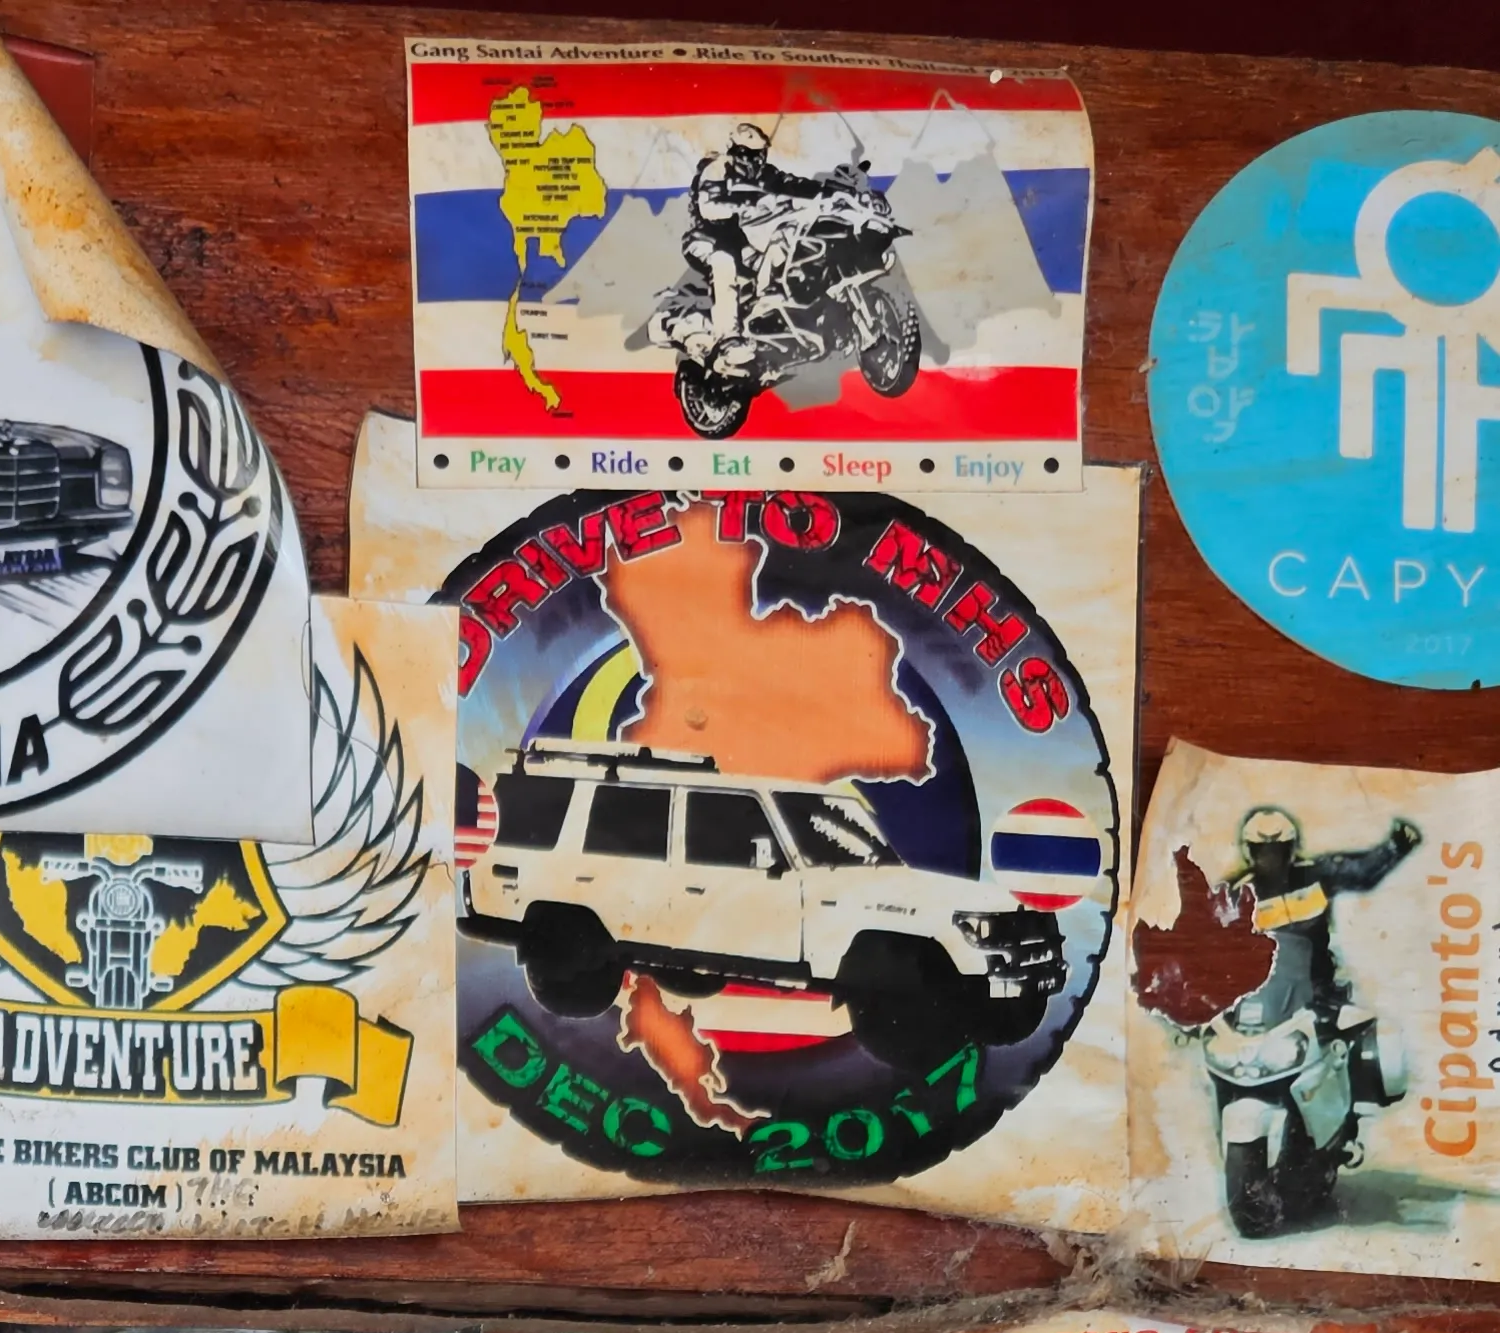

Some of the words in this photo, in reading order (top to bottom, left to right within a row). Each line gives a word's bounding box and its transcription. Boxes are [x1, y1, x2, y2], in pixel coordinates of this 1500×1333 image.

[410, 42, 470, 61] Gang
[476, 44, 543, 60] Santai
[550, 46, 664, 60] Adventure
[694, 47, 744, 61] Ride
[752, 50, 775, 62] To
[781, 50, 881, 67] Southern
[469, 450, 527, 475] Pray
[590, 450, 649, 475] Ride
[712, 453, 752, 476] Eat
[822, 453, 893, 483] Sleep
[953, 454, 1024, 486] Enjoy
[700, 490, 843, 552] TO
[863, 516, 1071, 734] MHS
[1420, 840, 1483, 1157] Cipanto's
[471, 1012, 672, 1157] DEC
[748, 1042, 981, 1174] 2017
[13, 1140, 119, 1170] BIKERS
[126, 1144, 201, 1173] CLUB
[209, 1149, 245, 1175] OF
[253, 1151, 408, 1179] MALAYSIA
